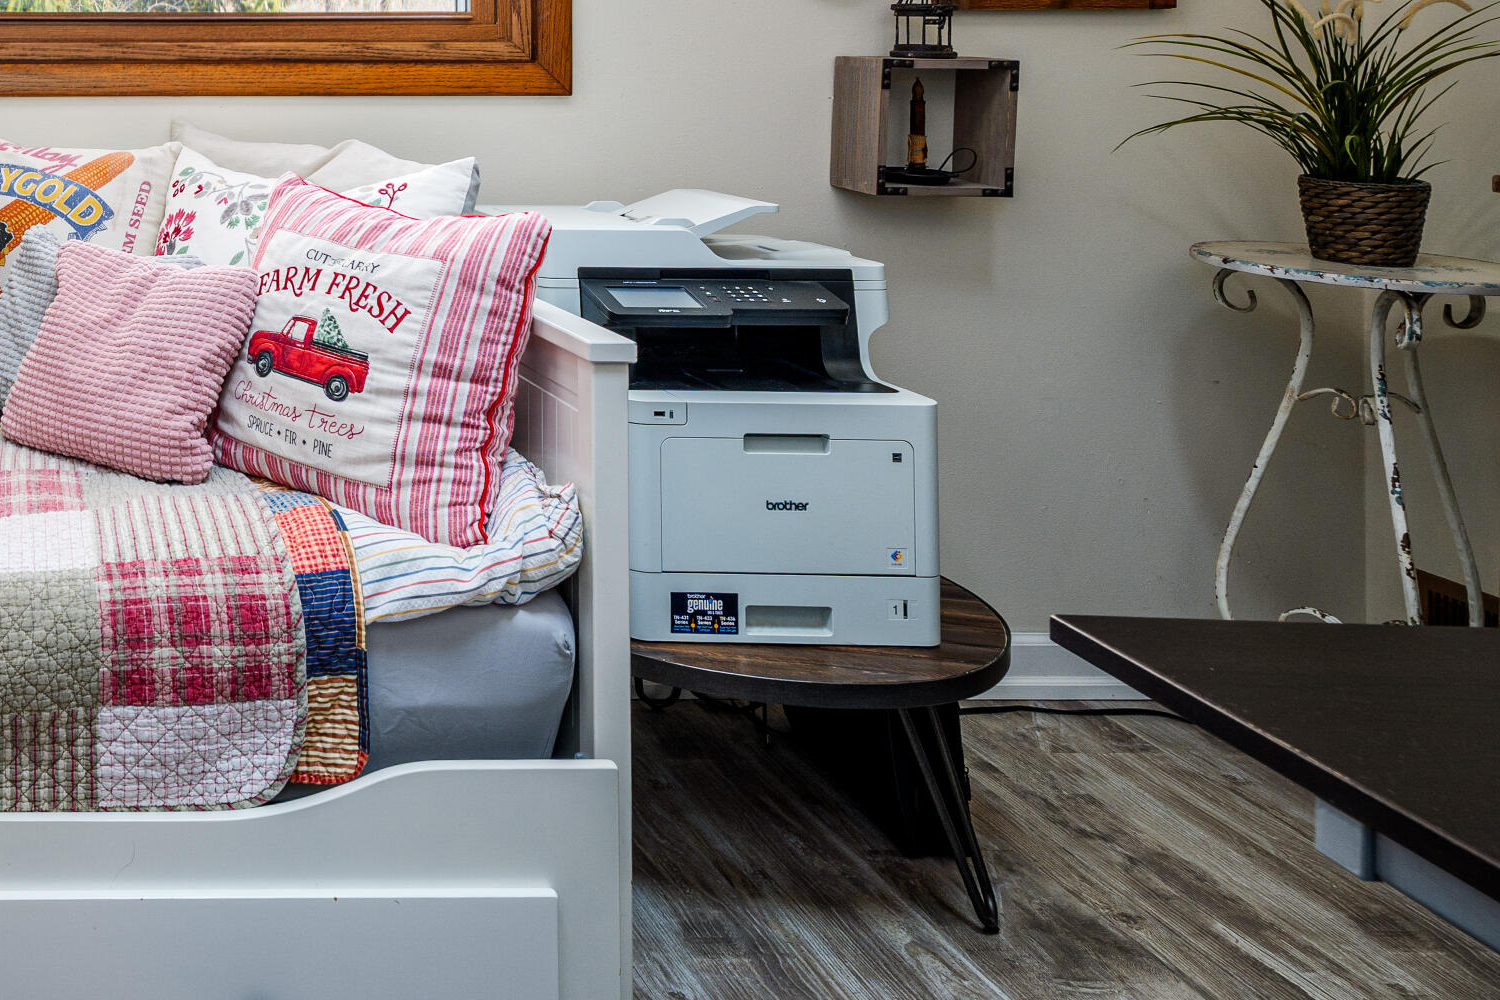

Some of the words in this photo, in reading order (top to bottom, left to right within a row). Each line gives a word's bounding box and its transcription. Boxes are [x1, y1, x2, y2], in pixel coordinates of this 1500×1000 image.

[129, 180, 152, 230] SEED
[306, 248, 332, 264] CUT
[256, 266, 321, 298] FARM
[326, 270, 412, 335] FRESH
[234, 379, 302, 422] Christmas
[304, 403, 365, 440] trees
[247, 414, 274, 438] SPRUCE
[284, 428, 298, 446] FIR
[313, 438, 333, 459] PINE
[765, 499, 809, 511] brother
[687, 599, 723, 613] genuine
[892, 605, 898, 615] 1
